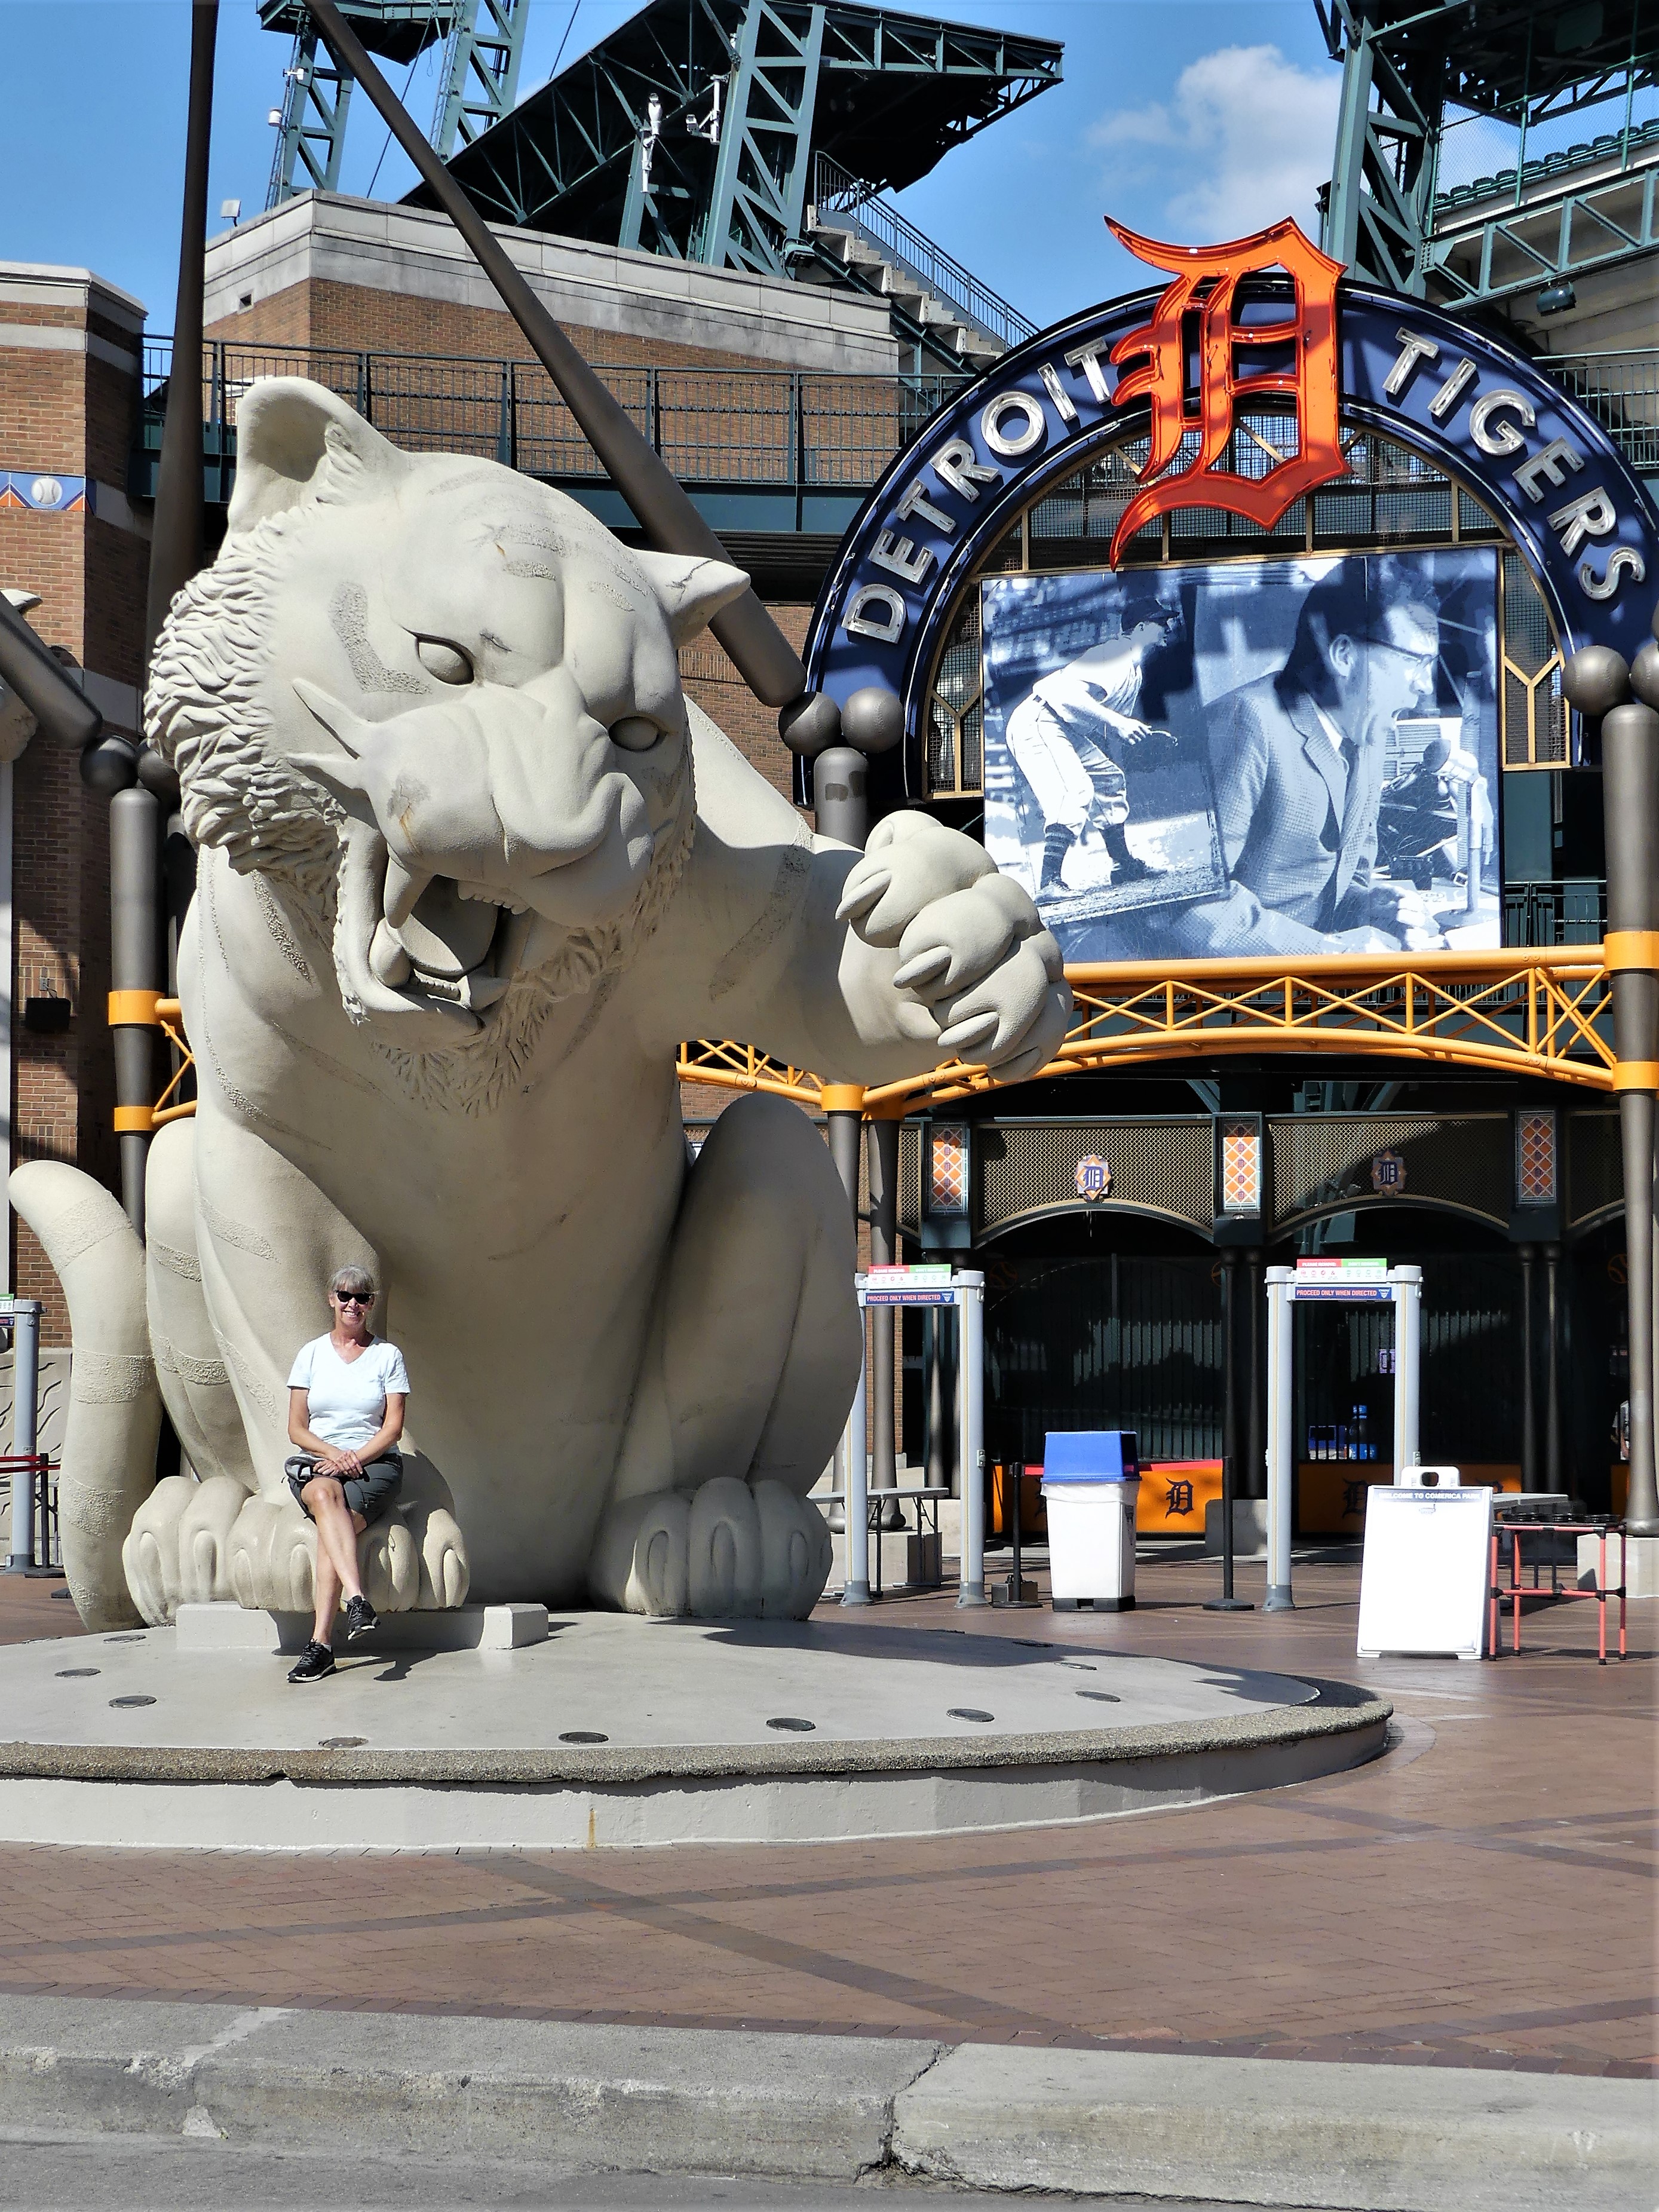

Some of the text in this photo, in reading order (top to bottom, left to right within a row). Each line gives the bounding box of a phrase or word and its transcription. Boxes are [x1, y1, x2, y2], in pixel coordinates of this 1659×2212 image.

[841, 327, 1646, 644] DETROIT TIGERS
[1103, 215, 1354, 572] D
[1166, 1478, 1194, 1519] D
